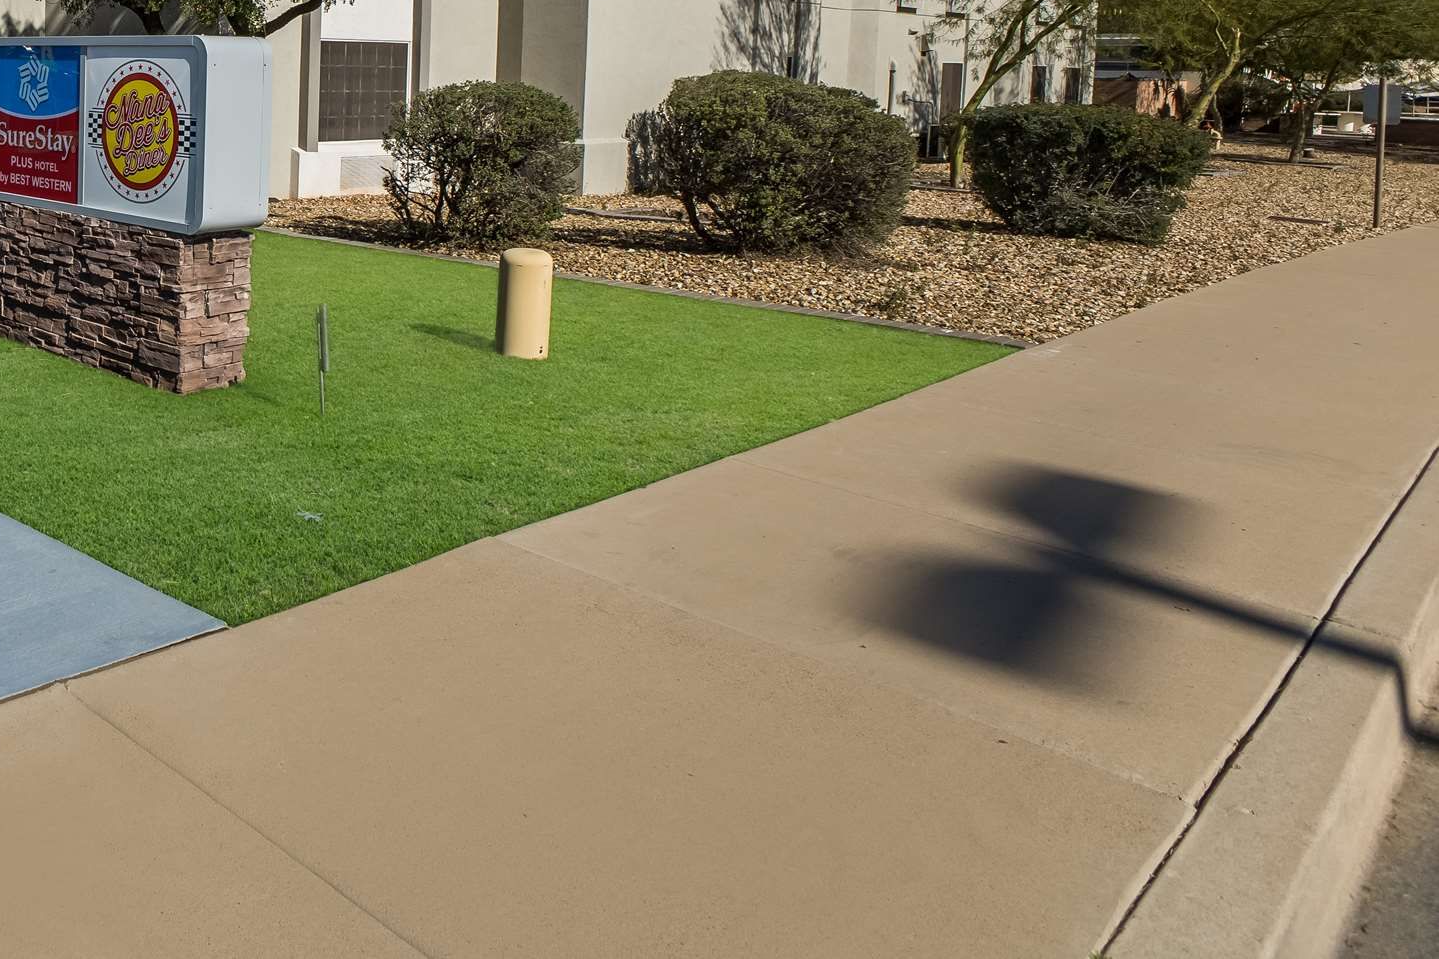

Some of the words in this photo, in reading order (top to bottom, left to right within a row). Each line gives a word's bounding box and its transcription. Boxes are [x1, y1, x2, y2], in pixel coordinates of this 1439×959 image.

[105, 89, 170, 130] Nana
[113, 117, 172, 158] Dee's
[10, 155, 33, 169] PLUS
[34, 161, 59, 172] HOTEL
[123, 144, 169, 177] Diner
[0, 170, 9, 185] by
[10, 172, 31, 187] BEST
[31, 175, 72, 193] WESTERN
